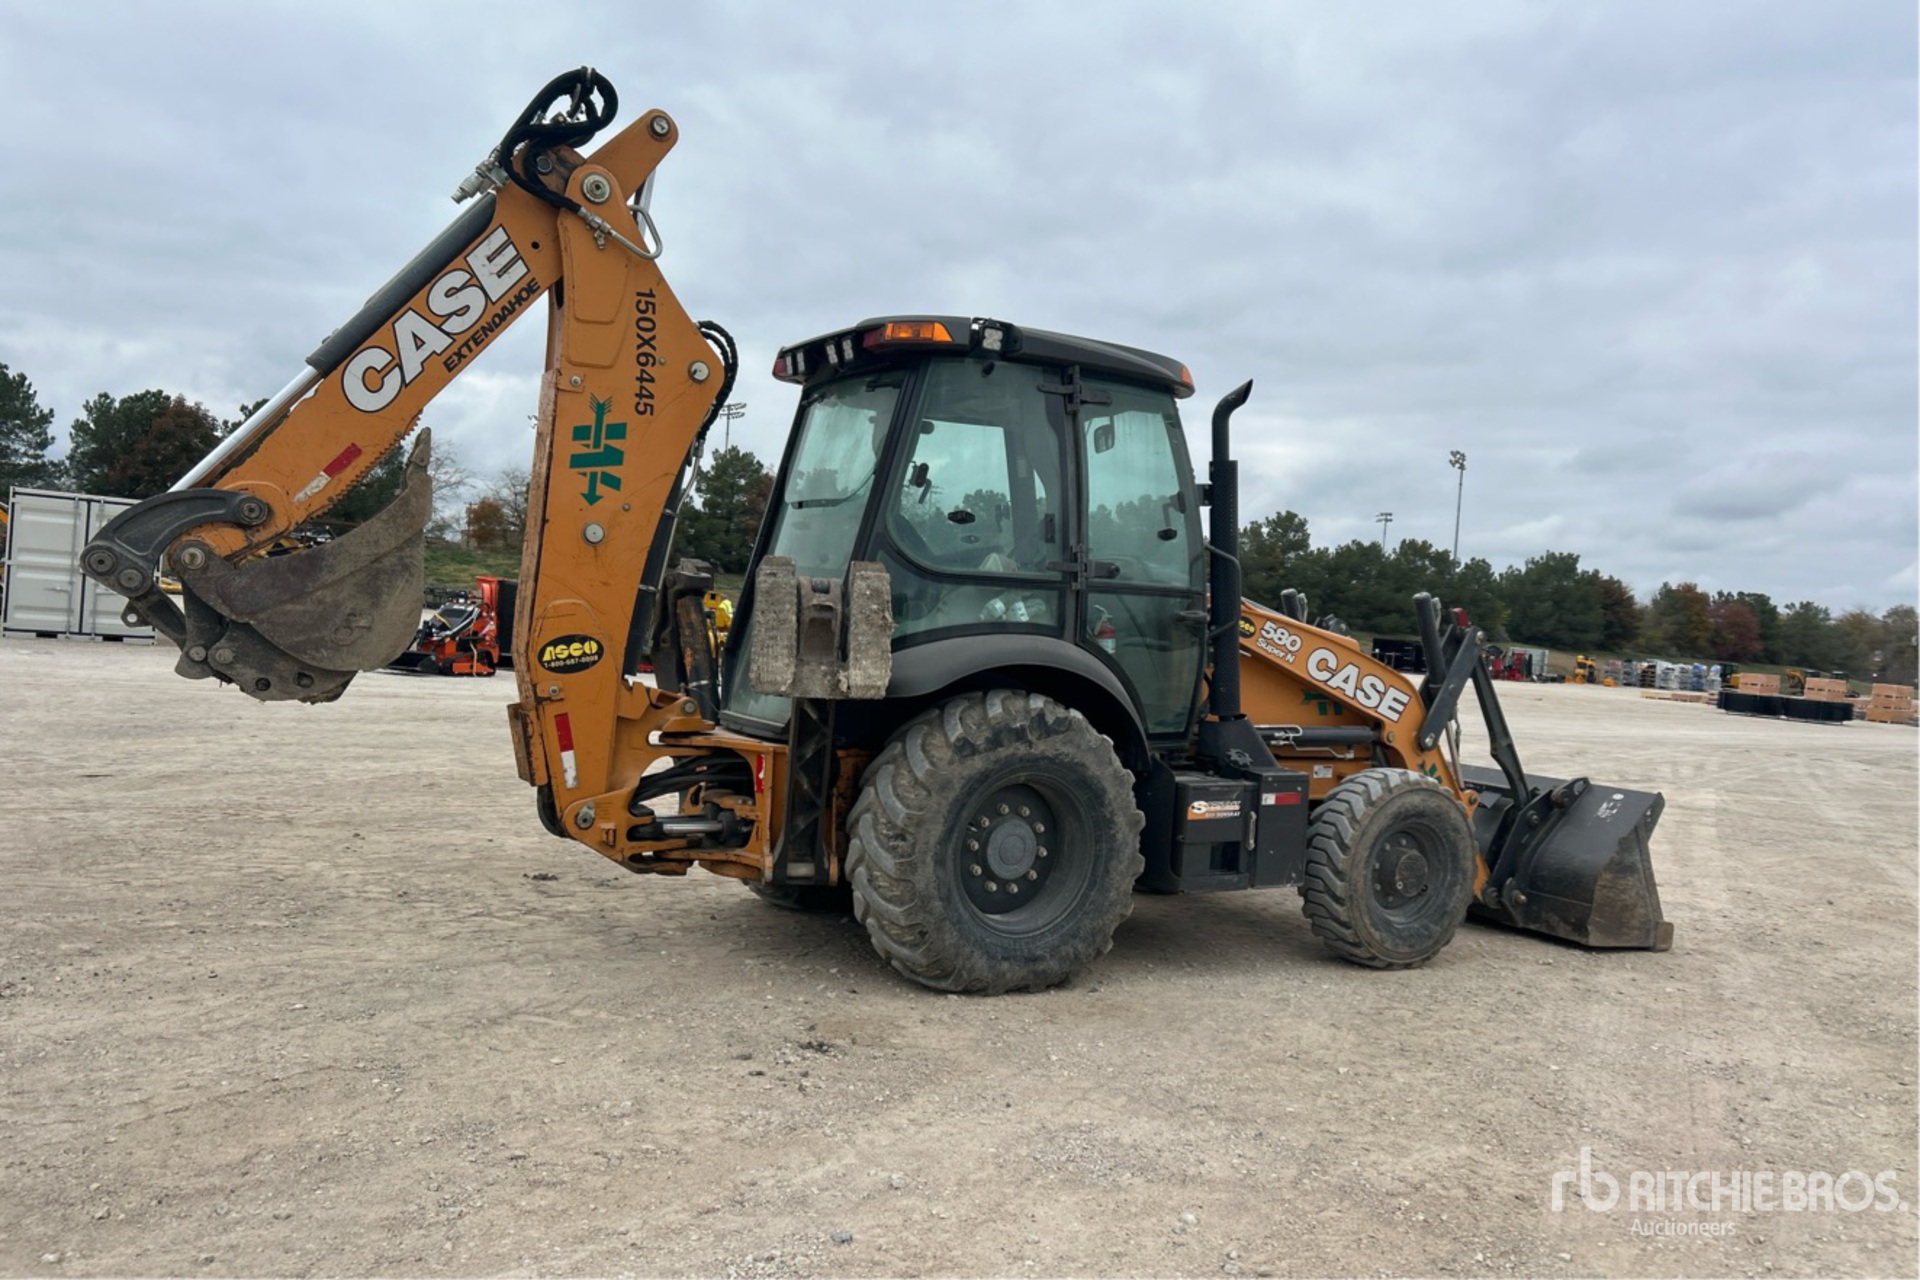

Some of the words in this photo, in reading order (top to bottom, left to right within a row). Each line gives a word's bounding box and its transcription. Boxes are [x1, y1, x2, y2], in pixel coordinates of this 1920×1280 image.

[341, 224, 530, 413] CASE
[442, 277, 541, 373] EXTENDAHOE
[634, 287, 657, 417] 150X6445
[542, 640, 598, 661] ASCO
[1256, 637, 1286, 658] Super
[1260, 620, 1302, 652] 580
[1306, 647, 1412, 723] CASE
